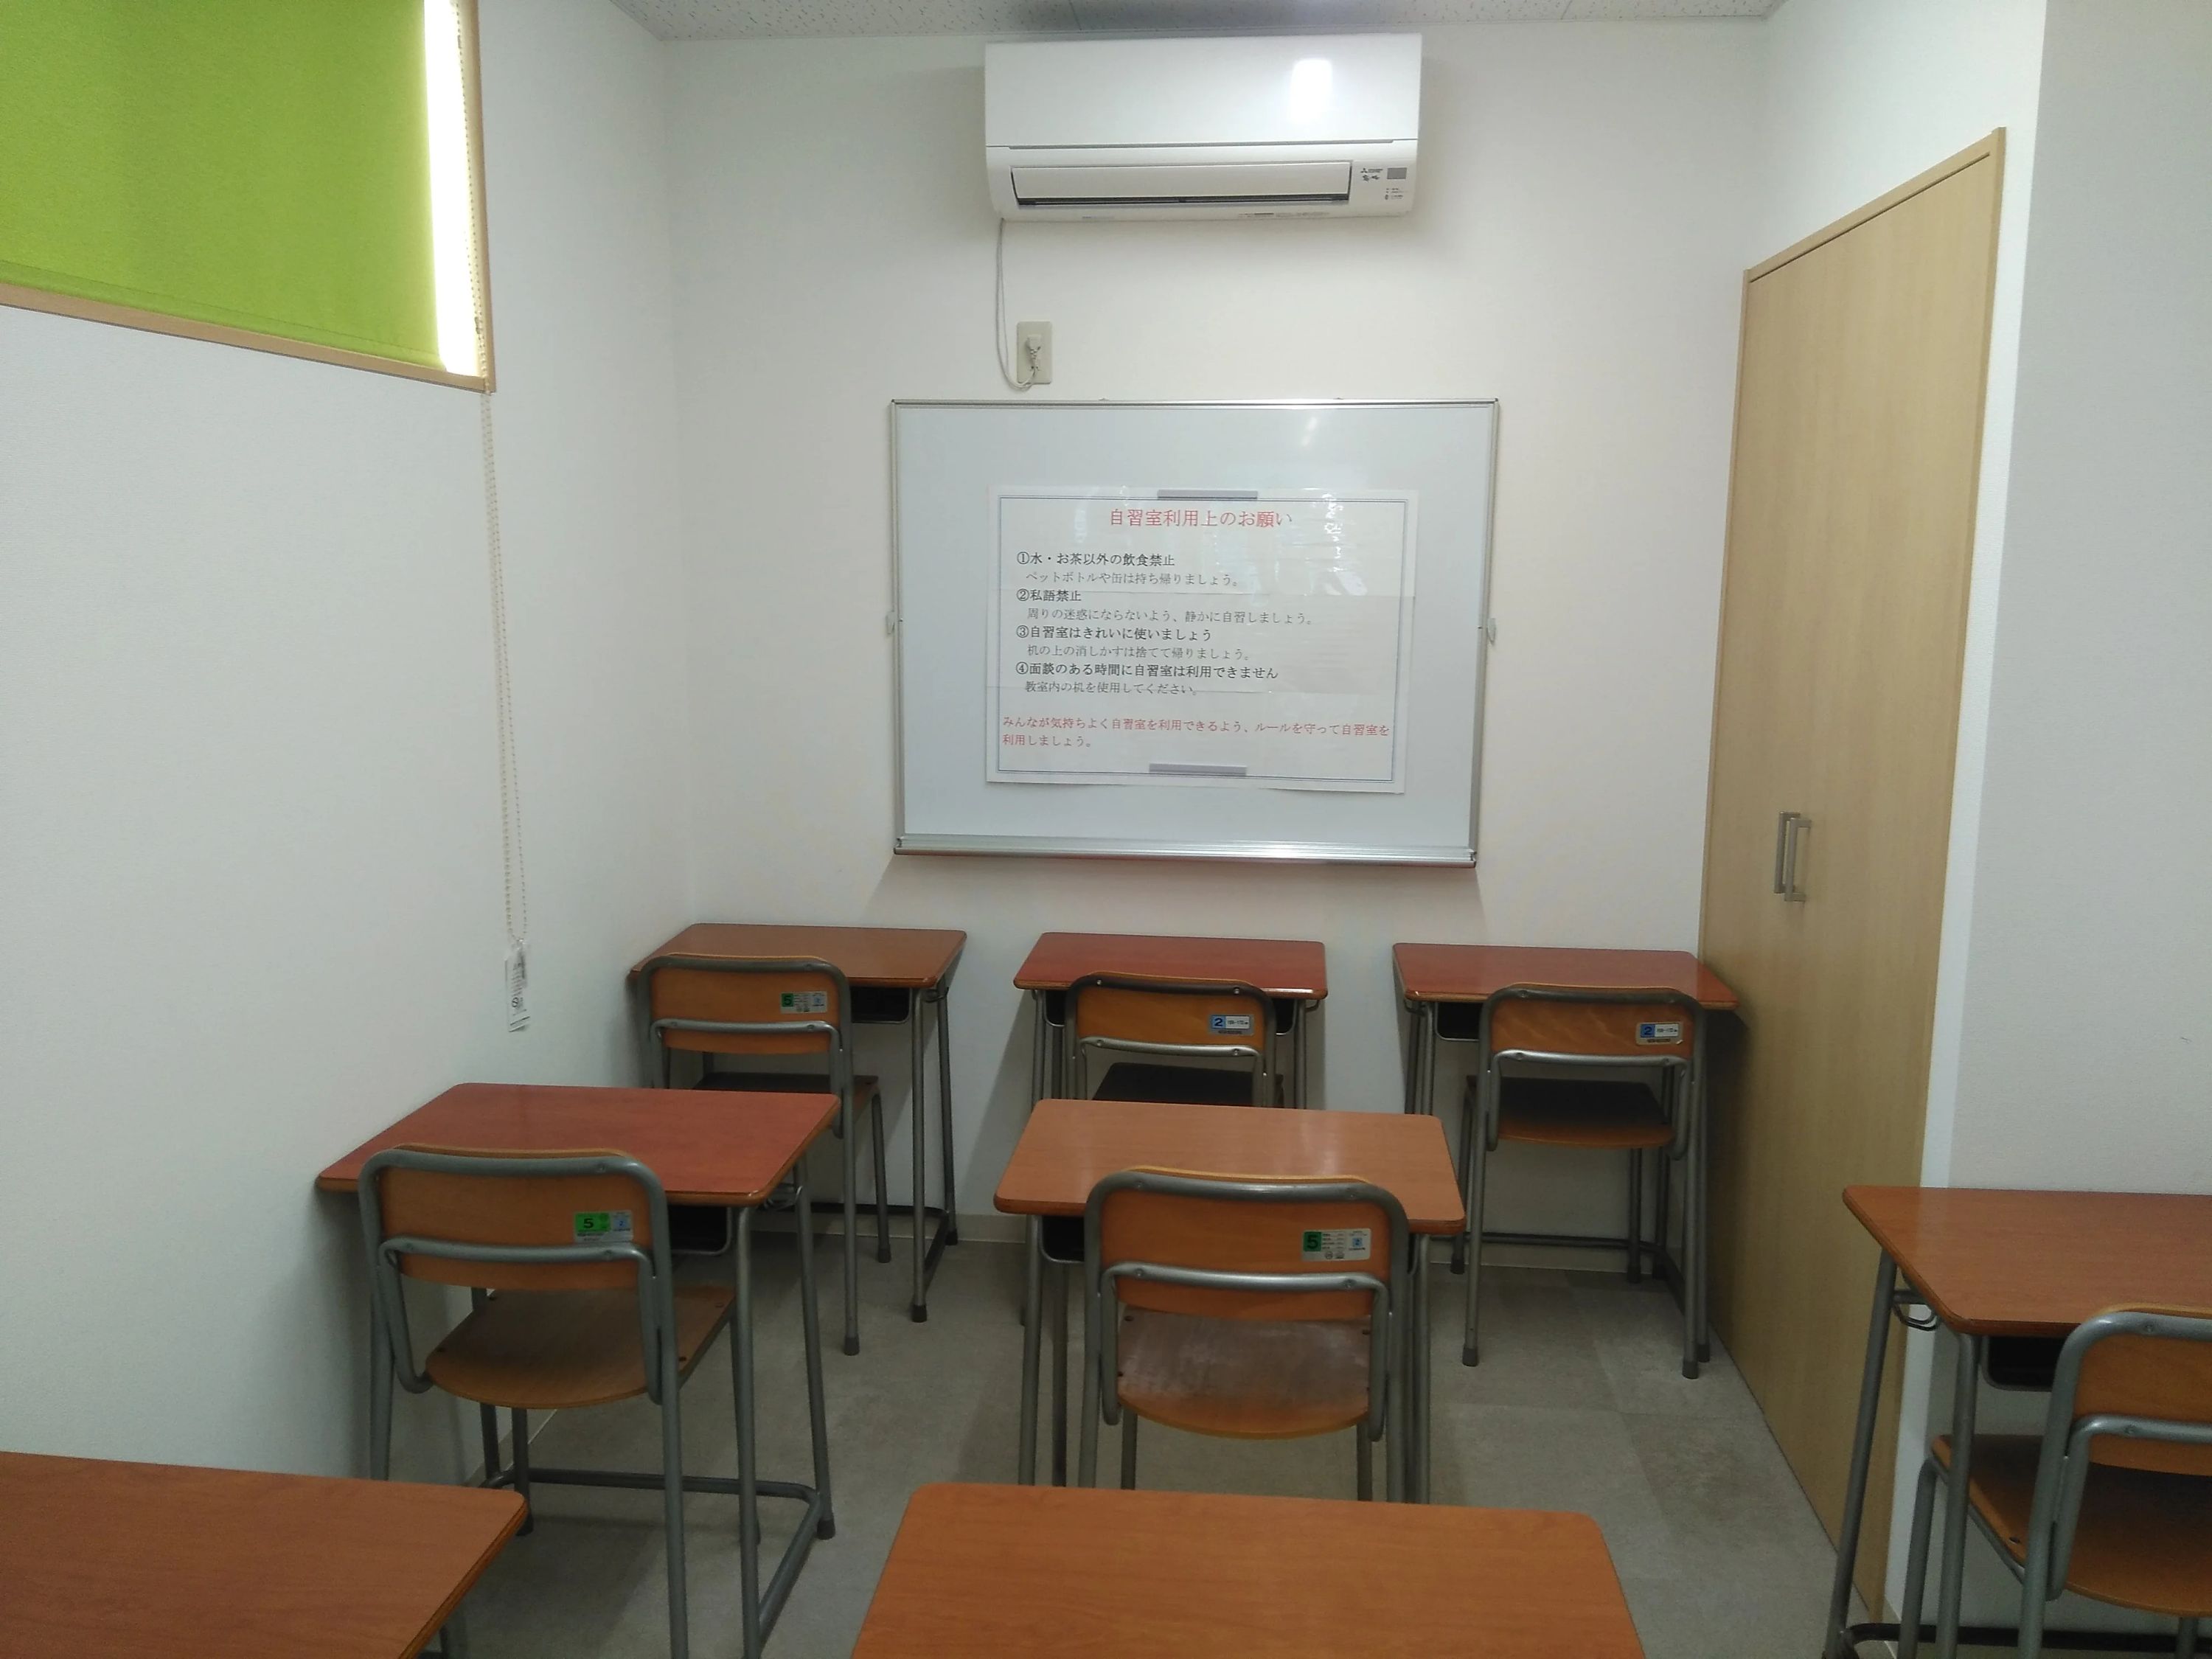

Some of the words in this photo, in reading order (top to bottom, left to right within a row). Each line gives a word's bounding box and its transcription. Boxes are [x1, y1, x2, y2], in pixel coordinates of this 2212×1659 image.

[1109, 509, 1293, 528] 自習室利用上のお願い
[1025, 570, 1239, 587] ペットボトルや缶は持ち帰りましょう。
[1016, 588, 1082, 602] ②私語禁止
[1027, 608, 1313, 625] 周りの迷惑にならないよう、静かに自習しましょう。
[1016, 625, 1211, 642] ③自習室はきれいに使いましょう
[1027, 644, 1251, 661] 机の上の消しかすは捨てて帰りましょう。
[1025, 681, 1197, 696] 教室内の机を使用してください。
[1003, 716, 1390, 737] みんなが気持ちよく自習室を利用できるよう、ルールを守って自習室を
[1003, 734, 1091, 748] 利用しましょう。
[1214, 1018, 1223, 1026] 2
[1644, 1026, 1653, 1035] 2
[1307, 1234, 1318, 1249] 5
